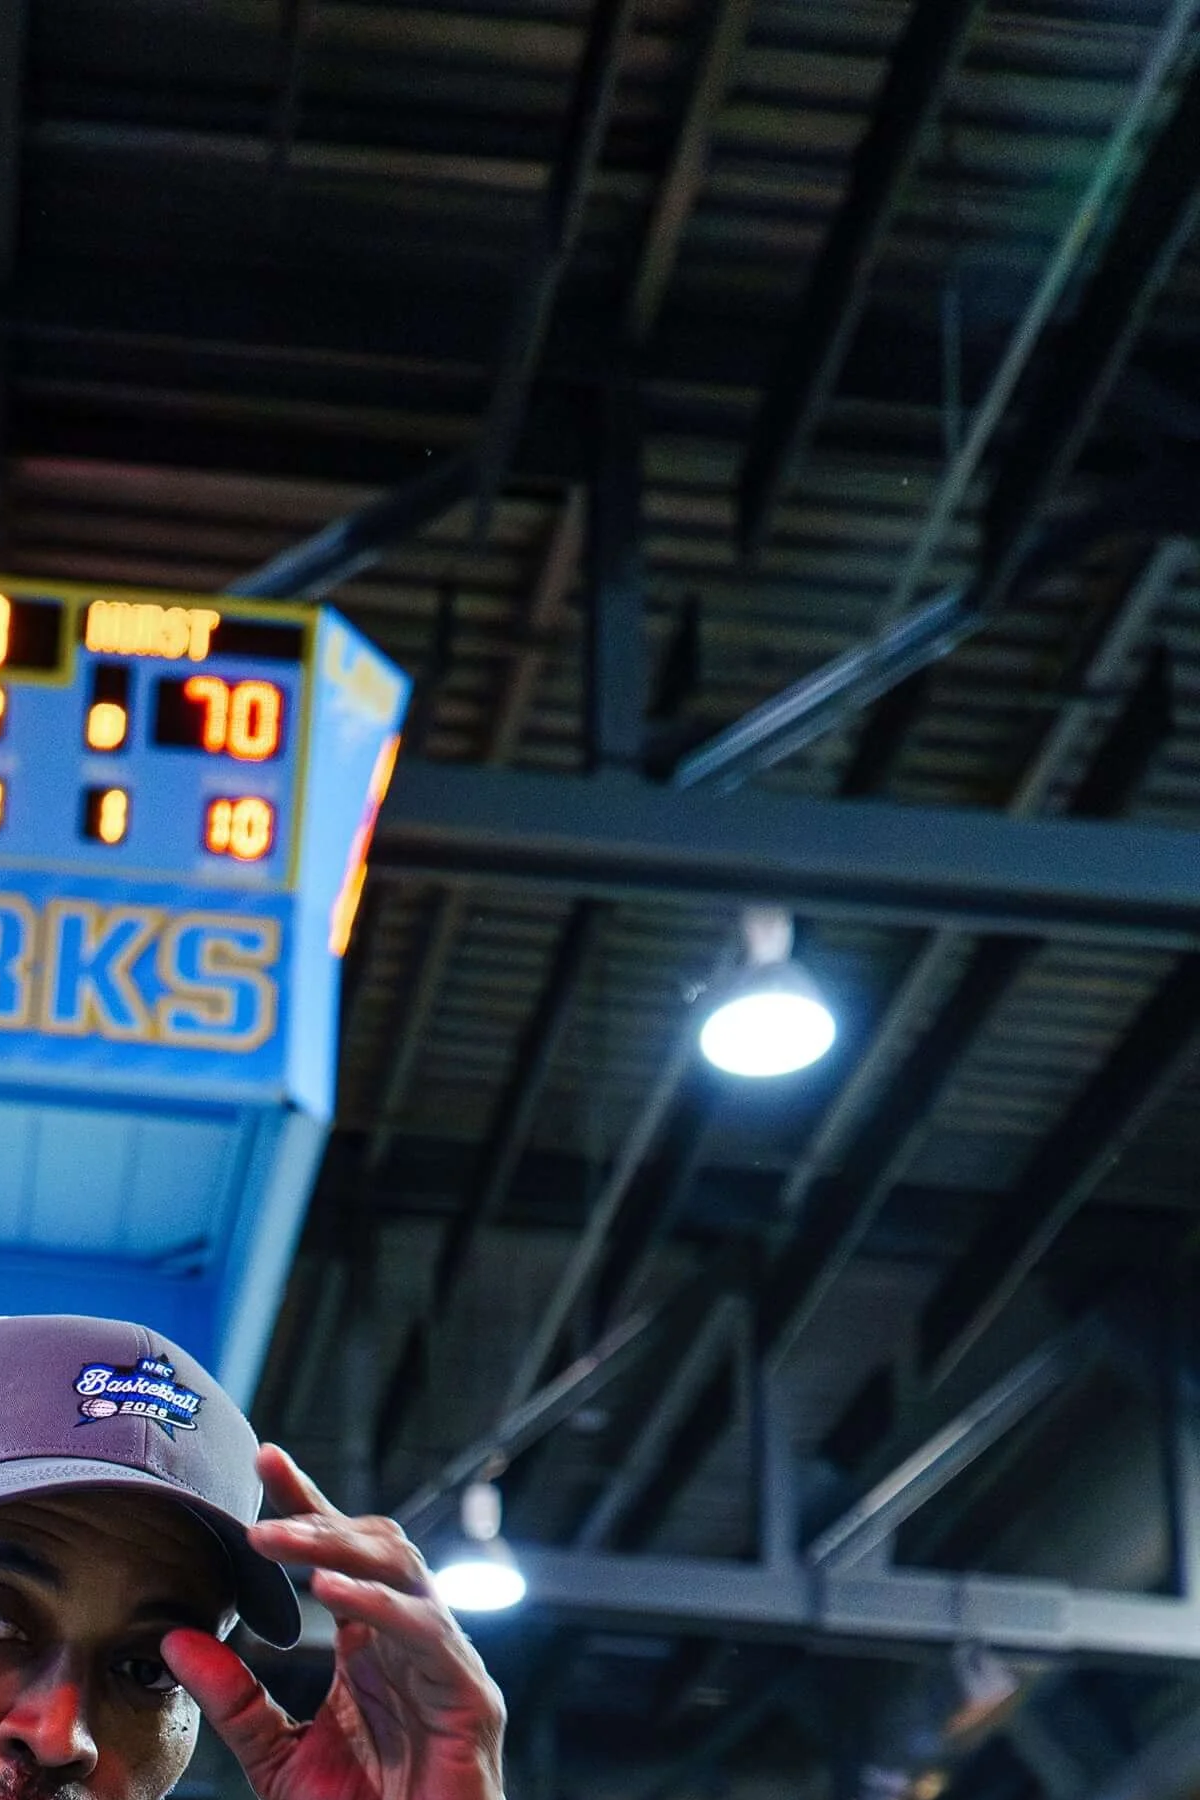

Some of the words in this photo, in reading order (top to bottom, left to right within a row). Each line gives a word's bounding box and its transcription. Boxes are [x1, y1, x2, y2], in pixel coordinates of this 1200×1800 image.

[184, 675, 284, 762] 70
[206, 795, 274, 862] 10
[76, 1368, 200, 1414] Basketball
